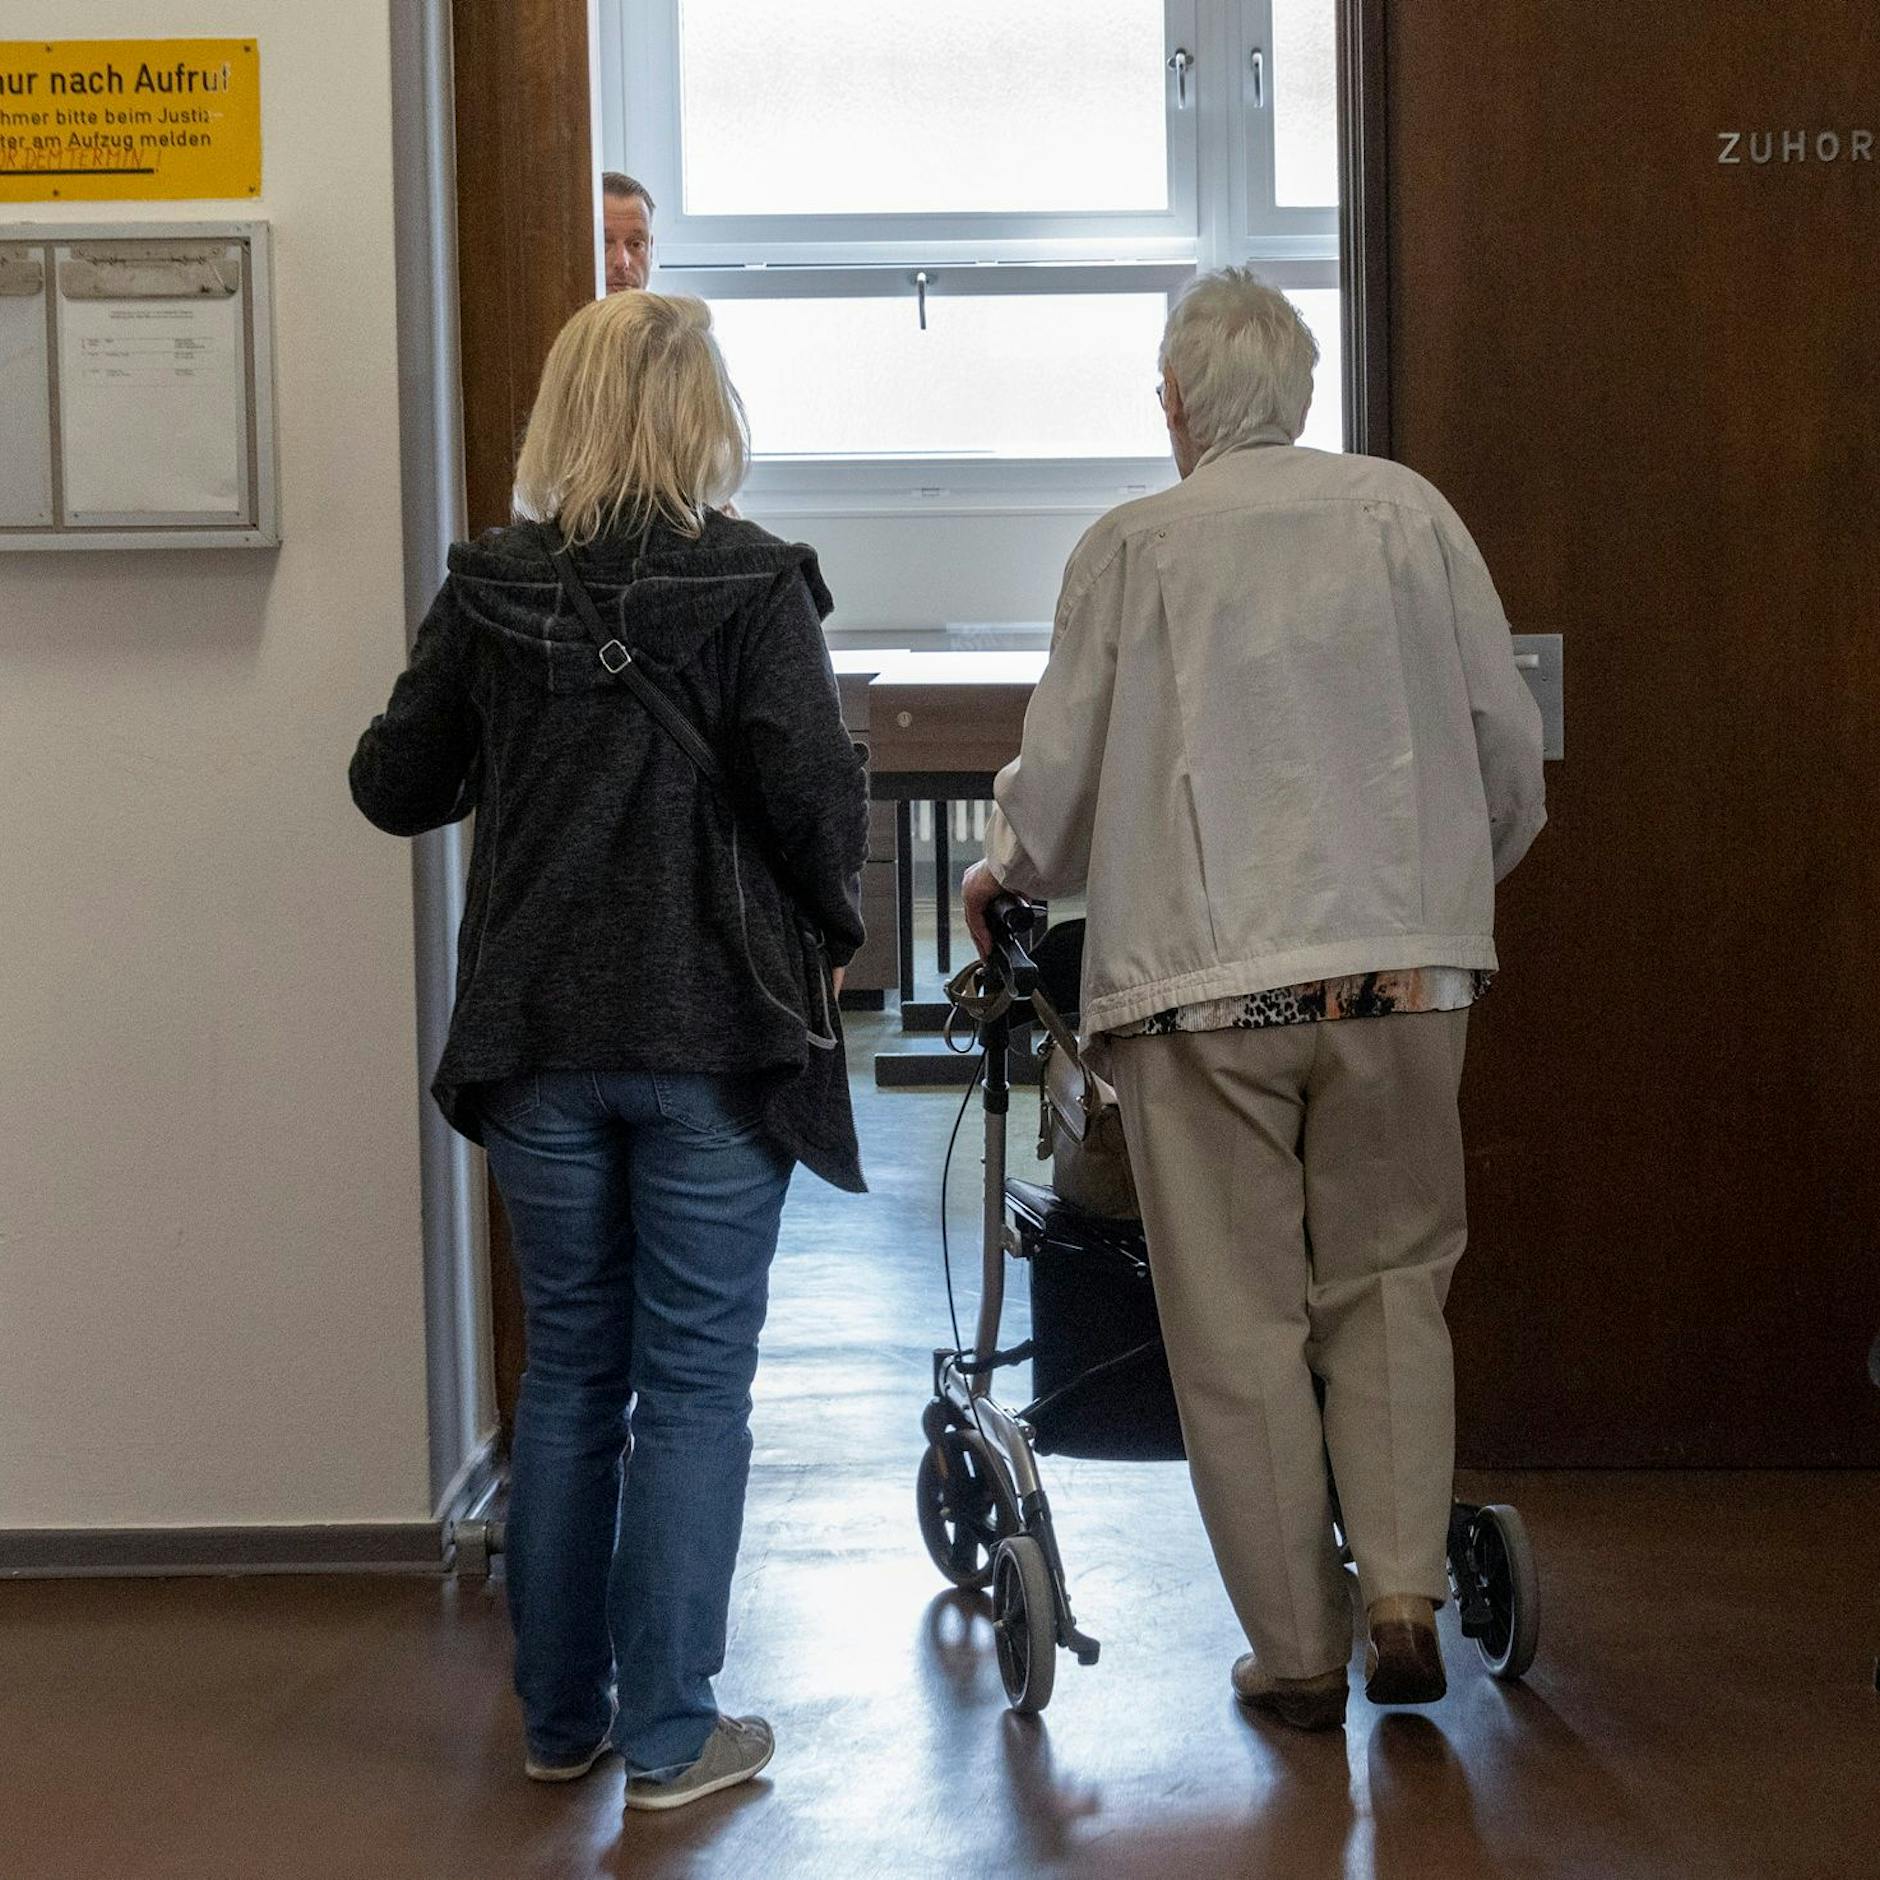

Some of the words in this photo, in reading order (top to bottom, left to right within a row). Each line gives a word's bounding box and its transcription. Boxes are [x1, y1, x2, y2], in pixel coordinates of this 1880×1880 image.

[51, 63, 123, 94] nach
[0, 108, 49, 125] hmer
[57, 109, 97, 125] bitte
[105, 108, 151, 125] beim
[33, 136, 61, 149] am
[69, 131, 133, 152] Aufzug
[140, 130, 211, 147] melden
